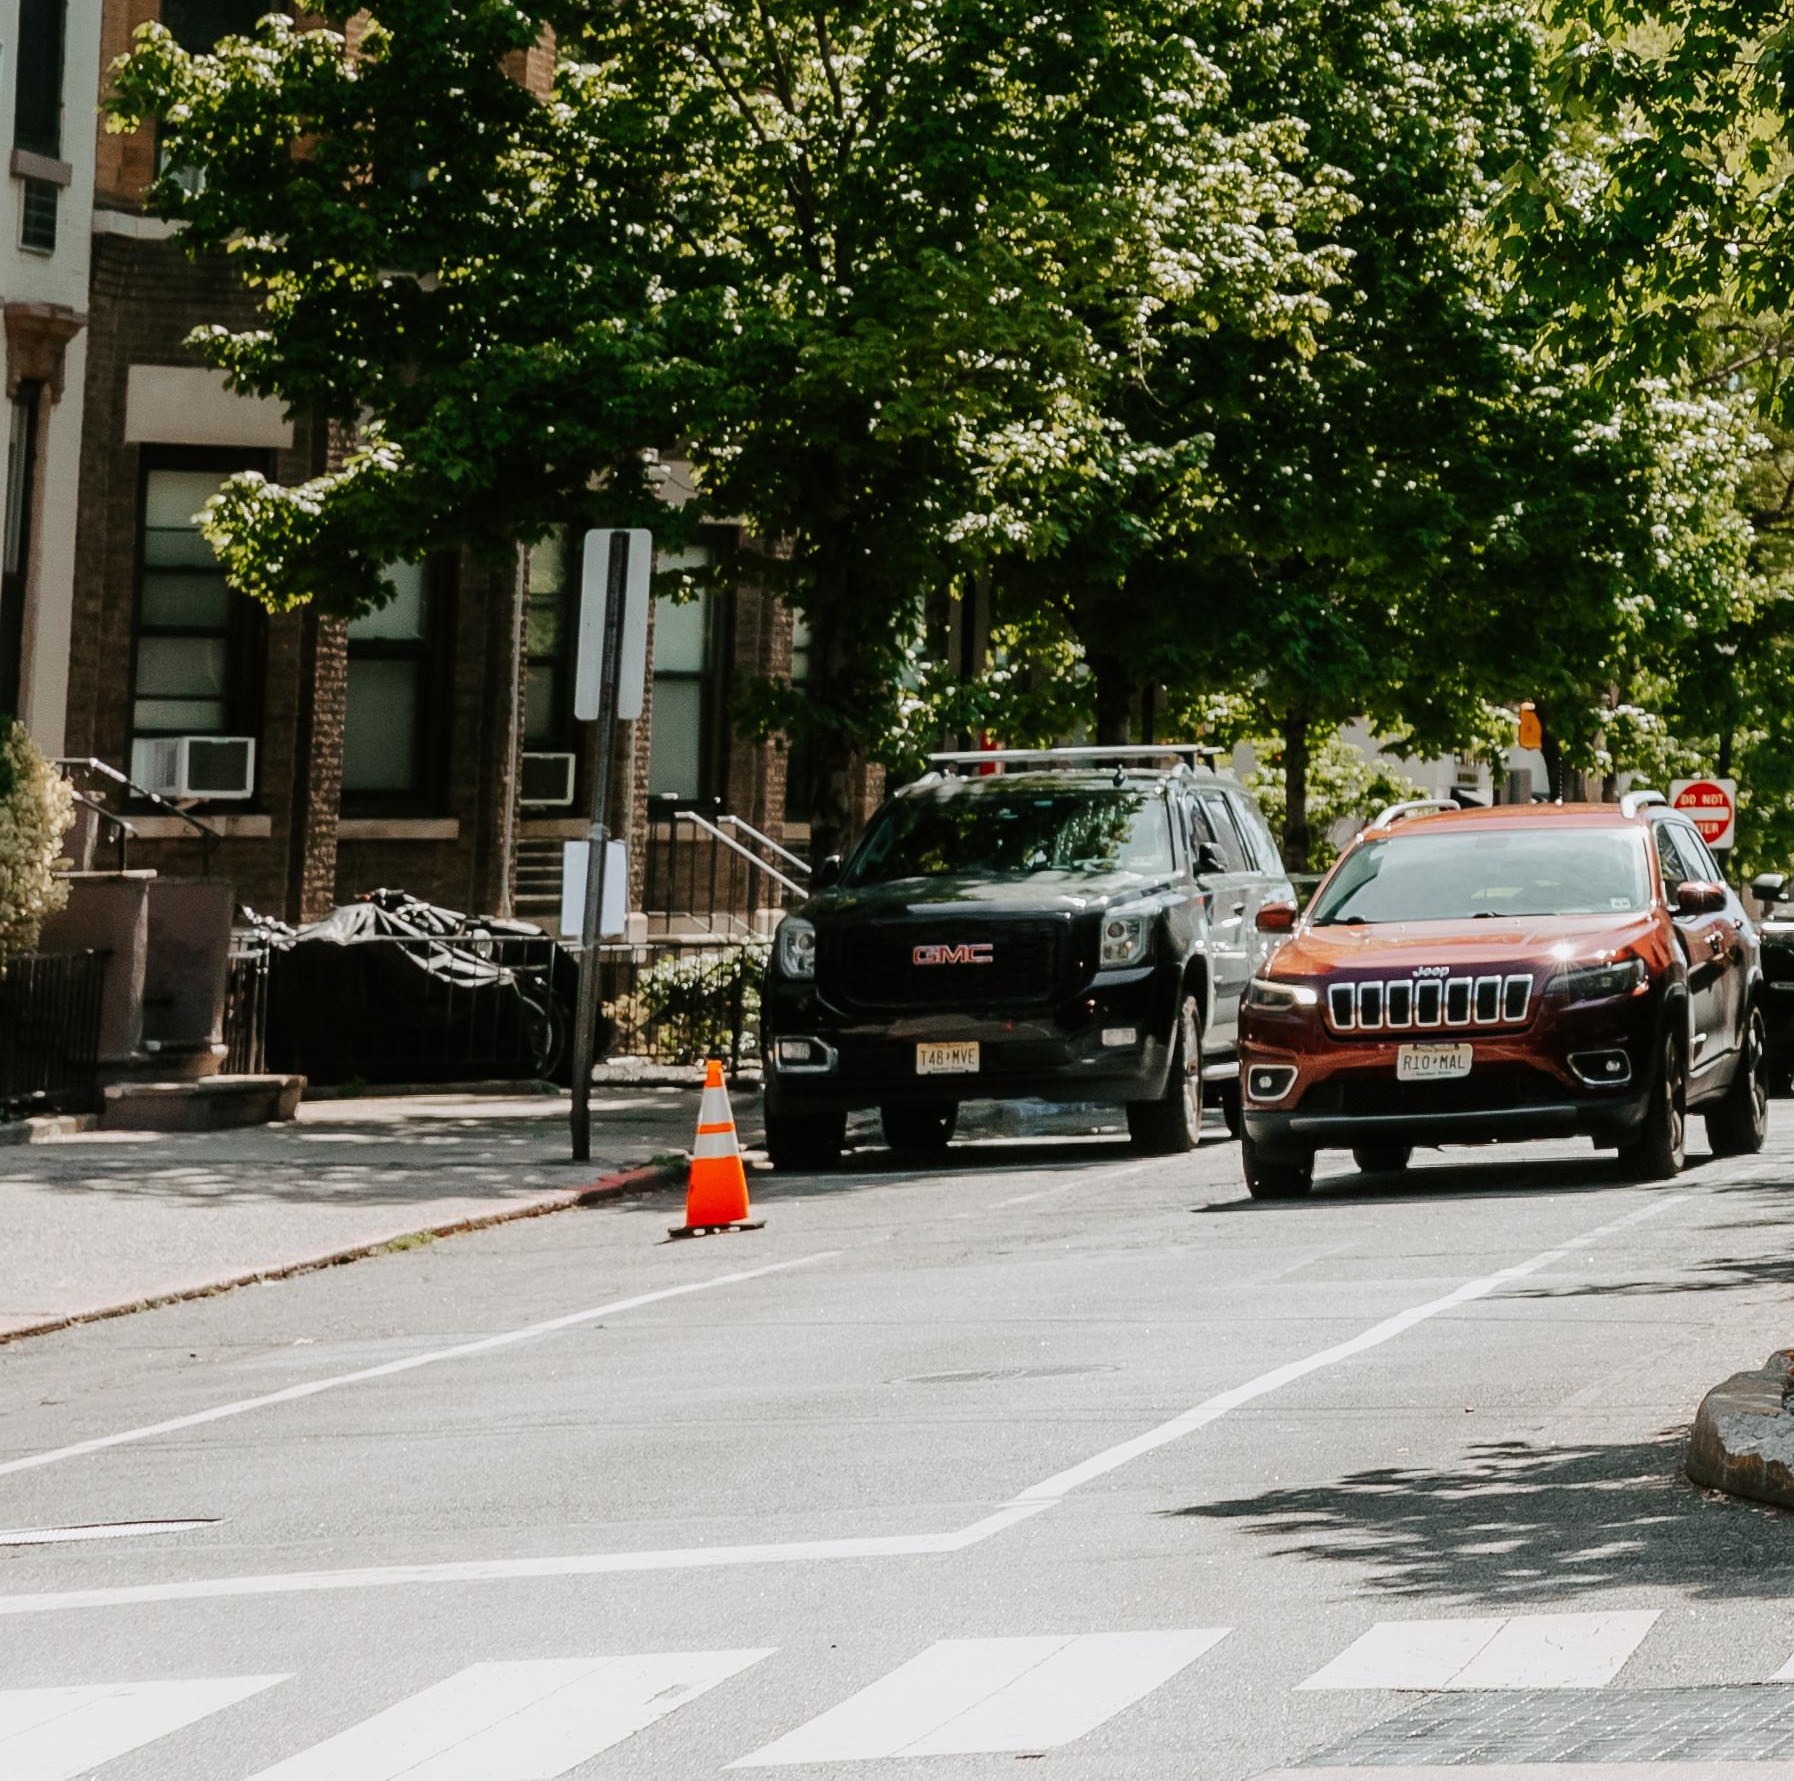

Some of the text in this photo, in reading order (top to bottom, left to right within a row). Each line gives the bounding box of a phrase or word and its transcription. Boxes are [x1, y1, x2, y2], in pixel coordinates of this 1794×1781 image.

[1680, 793, 1724, 805] DO NOT
[1696, 821, 1720, 835] TER
[913, 943, 994, 965] GMC
[1412, 966, 1450, 978] Jeep
